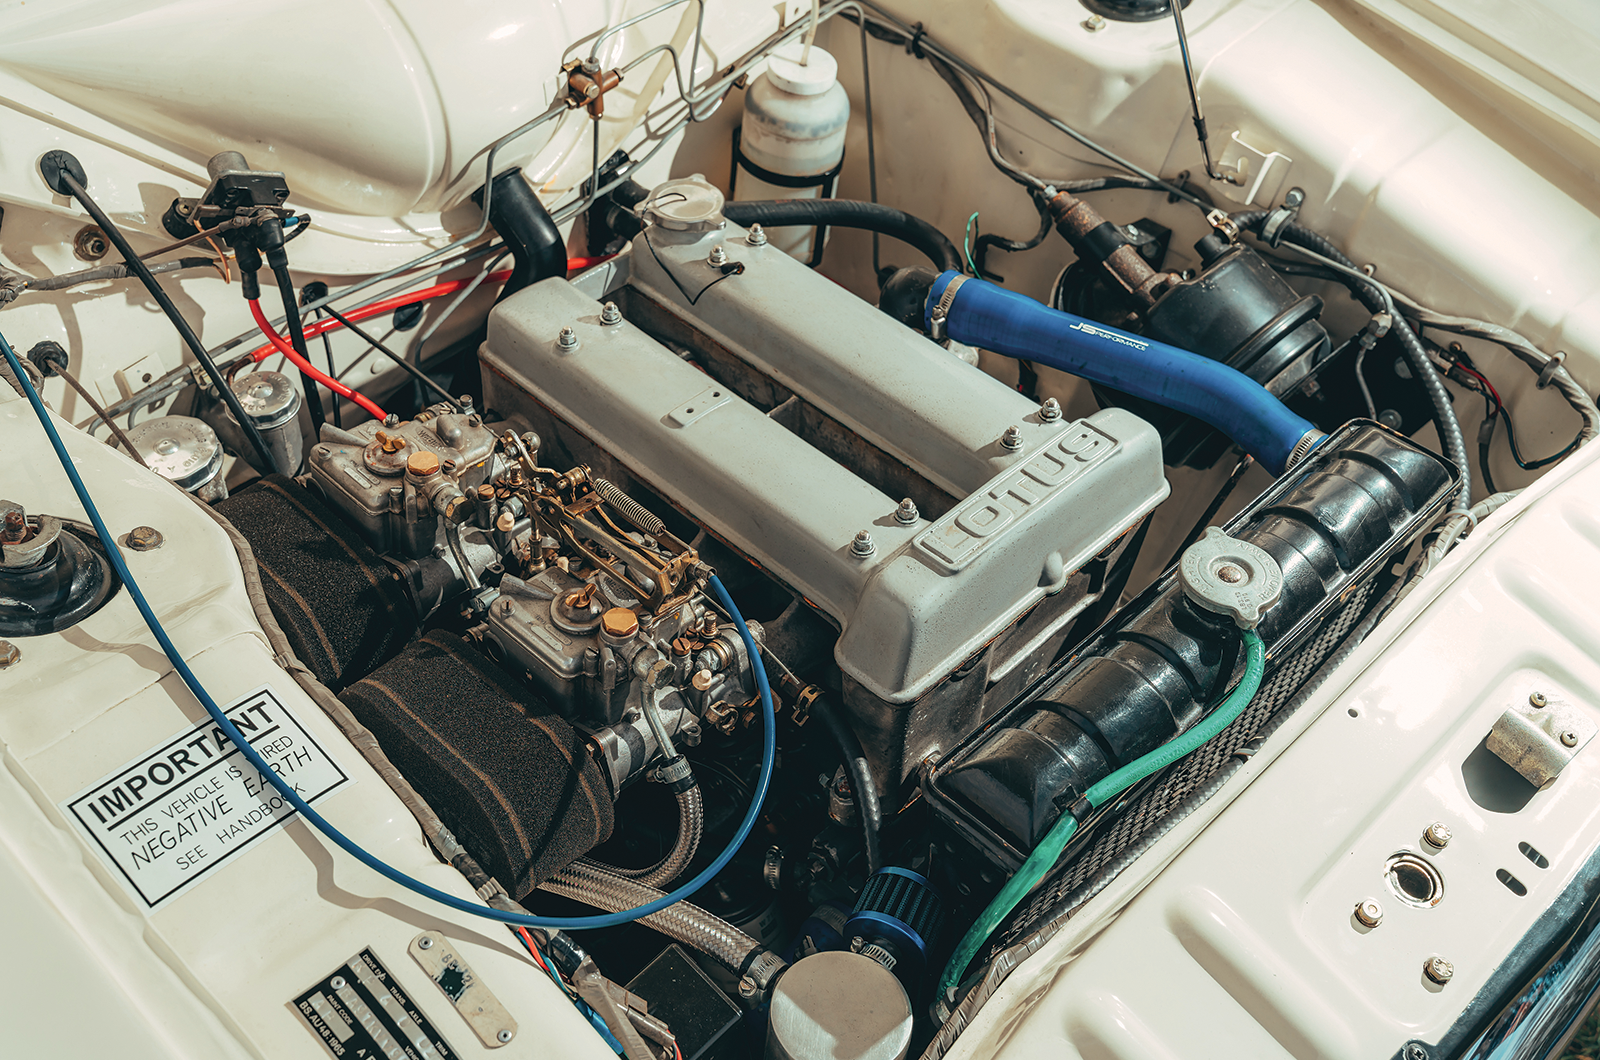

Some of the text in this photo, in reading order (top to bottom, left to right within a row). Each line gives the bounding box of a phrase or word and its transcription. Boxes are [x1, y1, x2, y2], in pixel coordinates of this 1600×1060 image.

[1069, 322, 1097, 335] JS
[918, 427, 1110, 564] LOTUS
[1236, 543, 1279, 600] REMOVE SLOWLY
[87, 700, 274, 824] IMPORTANT
[120, 735, 294, 846] THIS VEHICLE IS IRED
[130, 794, 234, 870] NEGATIVE
[175, 844, 208, 871] SEE
[326, 994, 354, 1026] PAINT CODE
[361, 953, 376, 971] DRIVE
[408, 1009, 423, 1025] AXLE
[434, 1040, 448, 1056] TRIM
